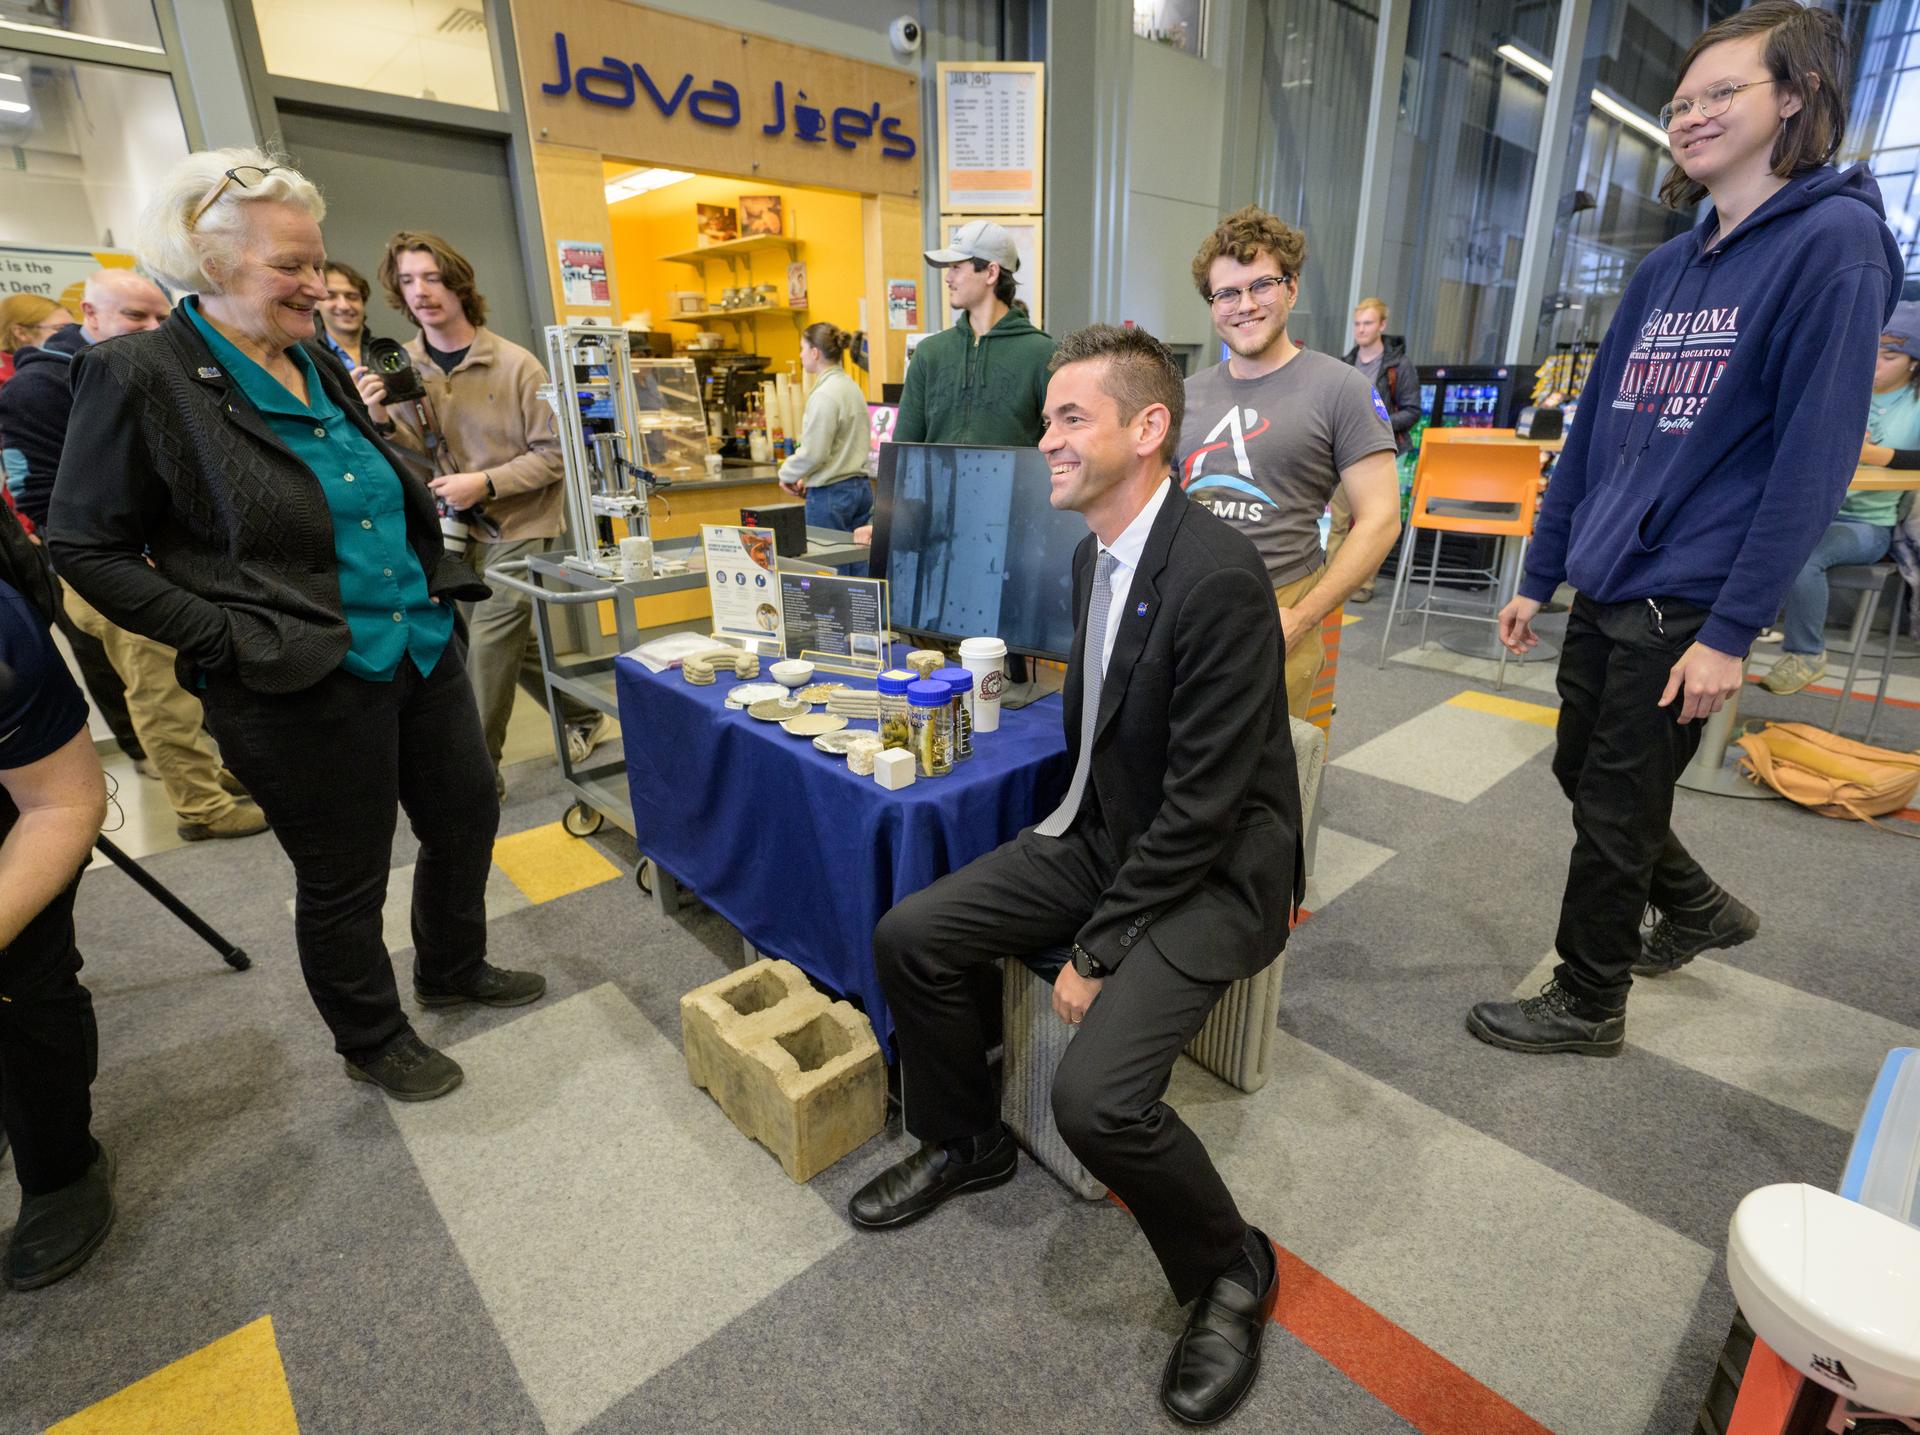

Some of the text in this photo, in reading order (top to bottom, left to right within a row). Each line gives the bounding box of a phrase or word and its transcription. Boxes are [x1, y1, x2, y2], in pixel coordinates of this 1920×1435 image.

[541, 32, 741, 128] Java
[7, 260, 22, 273] is
[25, 262, 53, 275] the
[10, 281, 52, 295] Den?
[1648, 306, 1739, 336] ARIZONA
[1672, 349, 1731, 360] ASOCIATION
